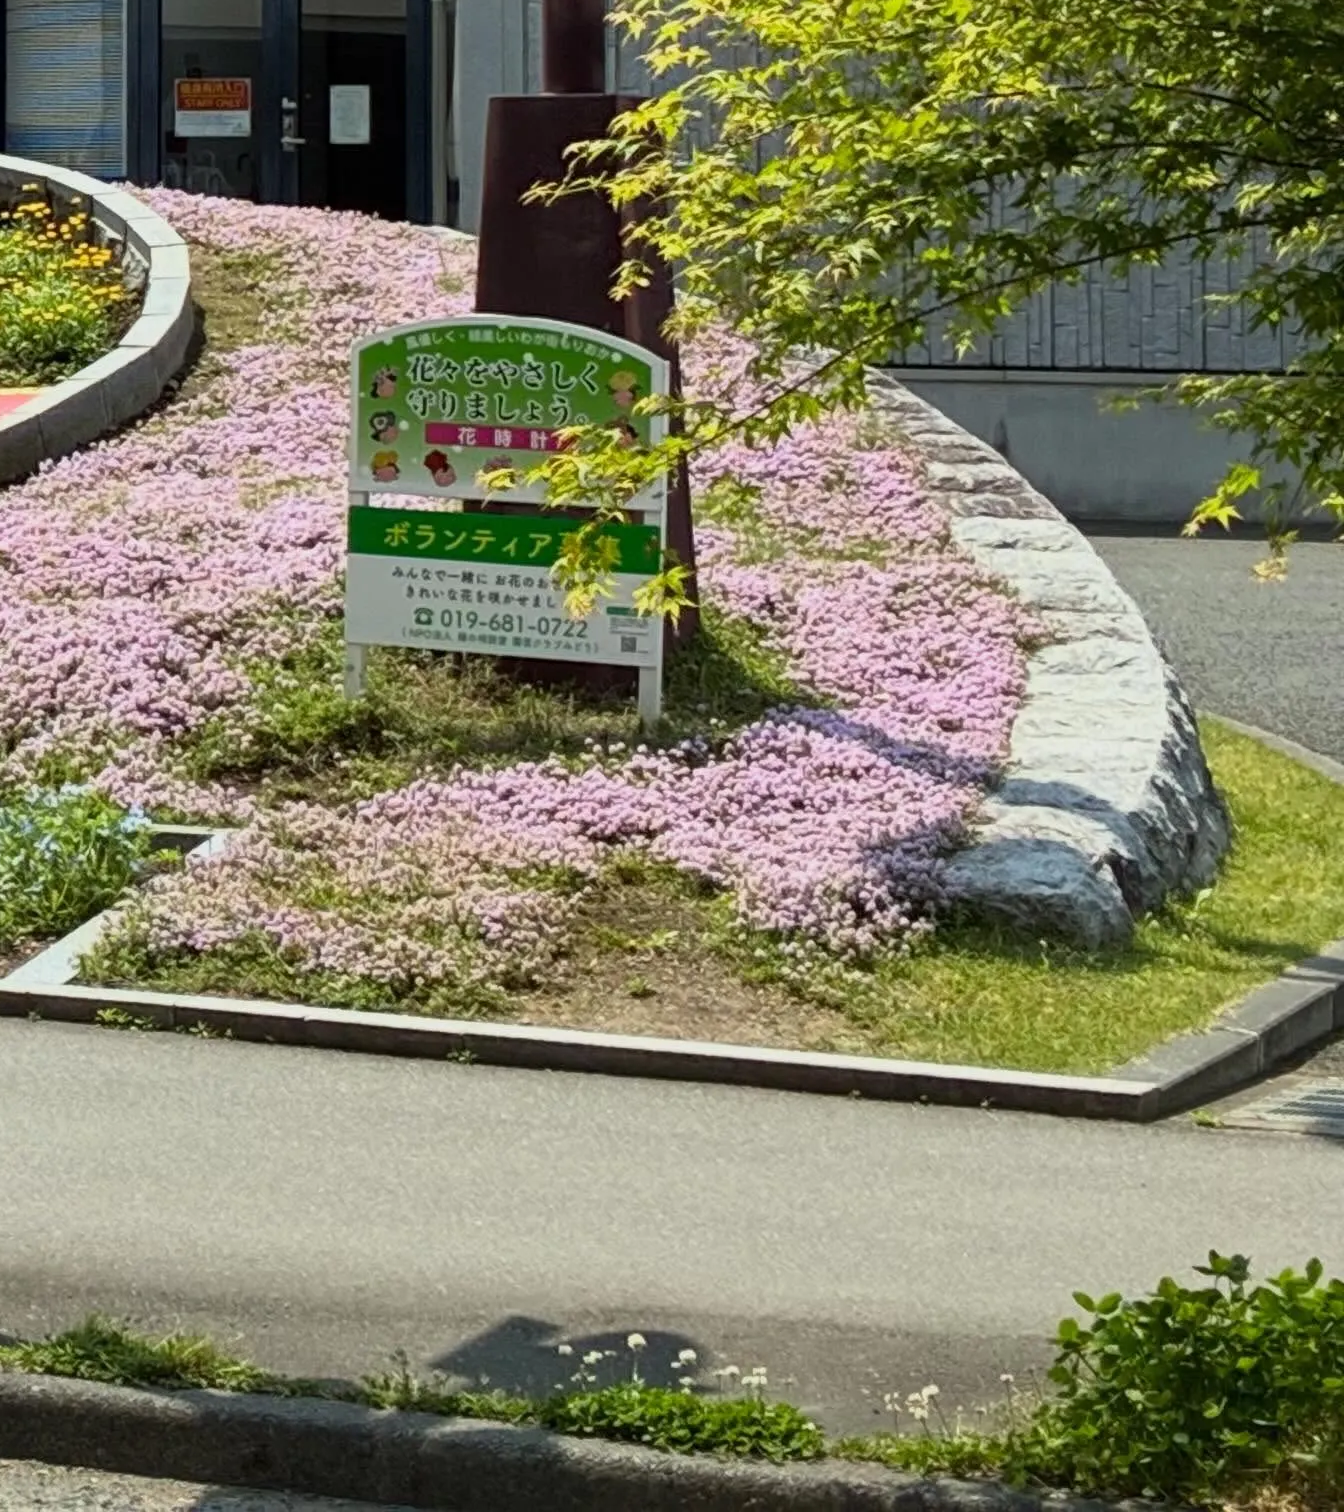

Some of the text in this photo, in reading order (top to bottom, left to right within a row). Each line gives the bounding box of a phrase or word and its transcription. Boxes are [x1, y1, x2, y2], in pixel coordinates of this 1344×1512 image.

[407, 353, 599, 394] 花々をやさしく
[407, 388, 590, 426] 守りましょう。
[457, 426, 548, 449] 花時計
[440, 609, 588, 638] 019-681-0722
